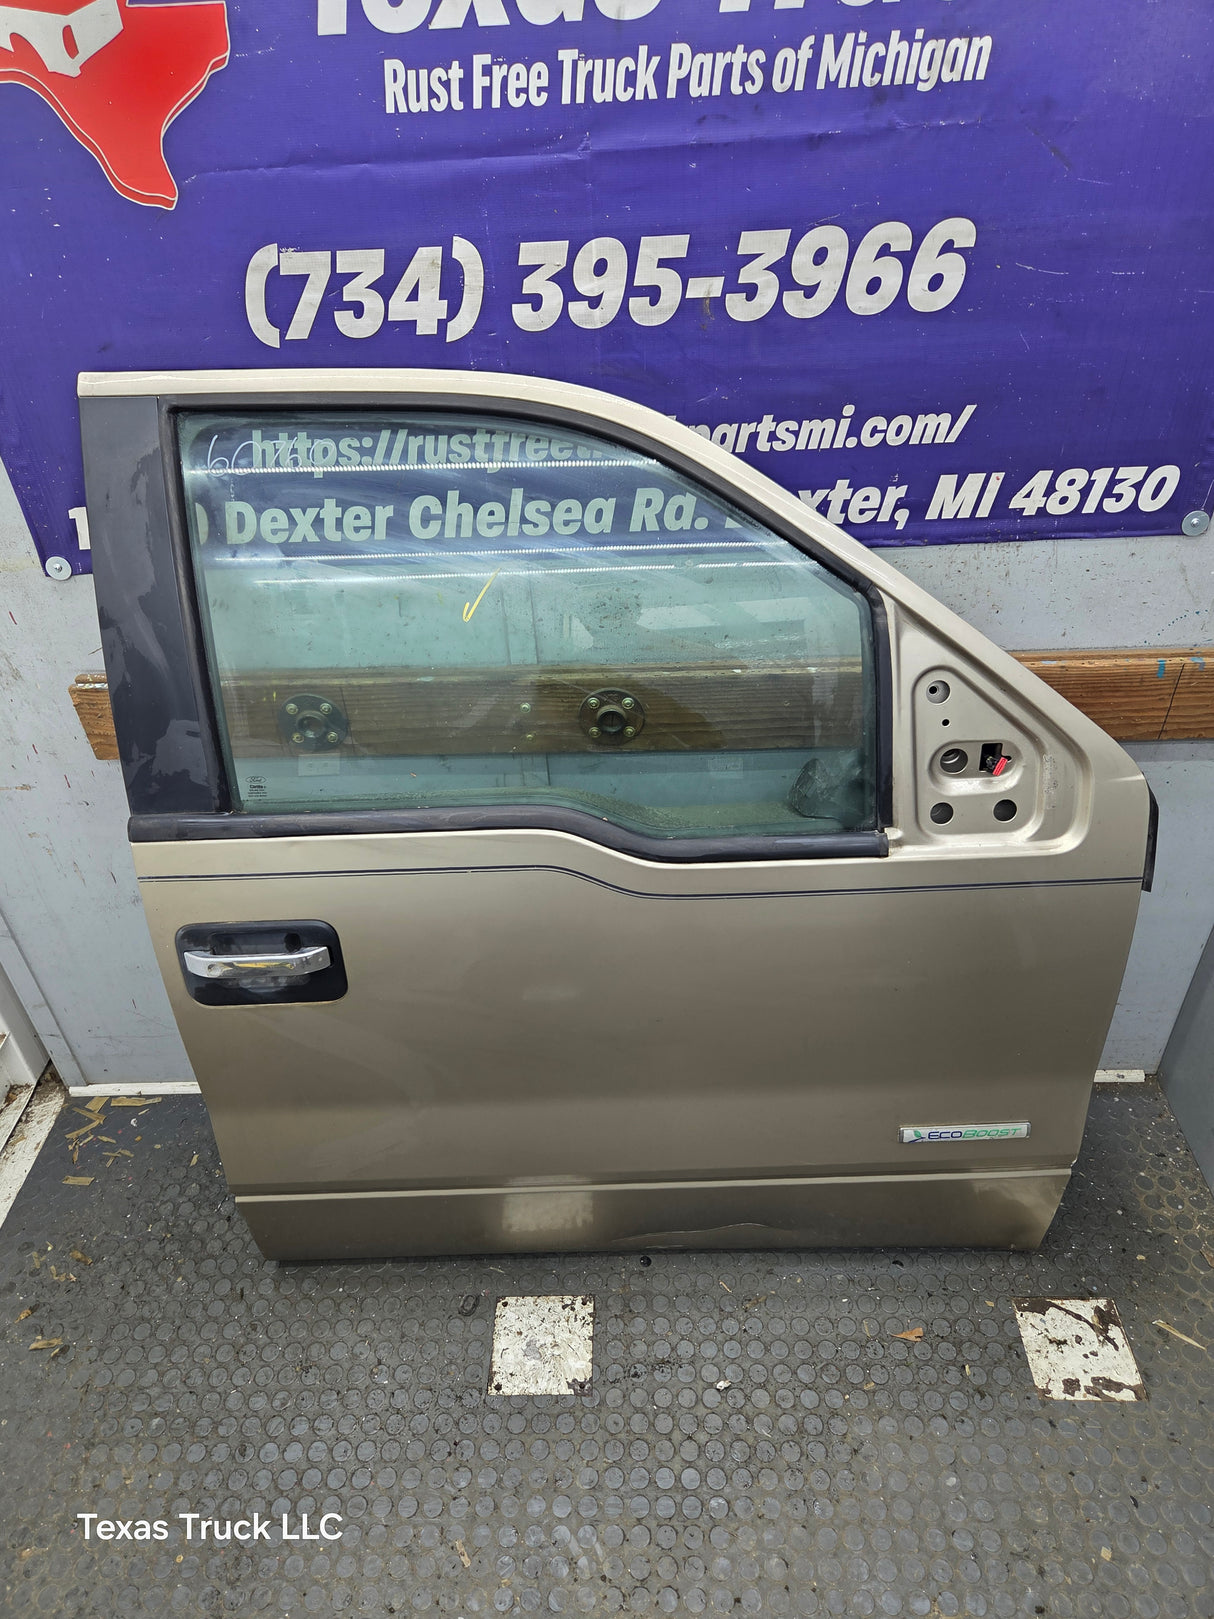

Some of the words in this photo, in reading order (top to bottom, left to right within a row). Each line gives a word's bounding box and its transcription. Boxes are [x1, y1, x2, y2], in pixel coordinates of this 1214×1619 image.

[384, 58, 464, 114] Rust
[472, 53, 549, 110] Free
[557, 44, 662, 105] Truck
[666, 42, 767, 99] Parts
[771, 34, 816, 93] of
[816, 28, 993, 92] Michigan
[245, 236, 485, 348] (734)
[511, 217, 977, 332] 395-3966
[224, 497, 394, 545] Dexter
[408, 487, 617, 541] Chelsea
[925, 471, 1005, 520] MI
[1009, 465, 1181, 517] 48130
[928, 1128, 1022, 1140] ECOBOOST
